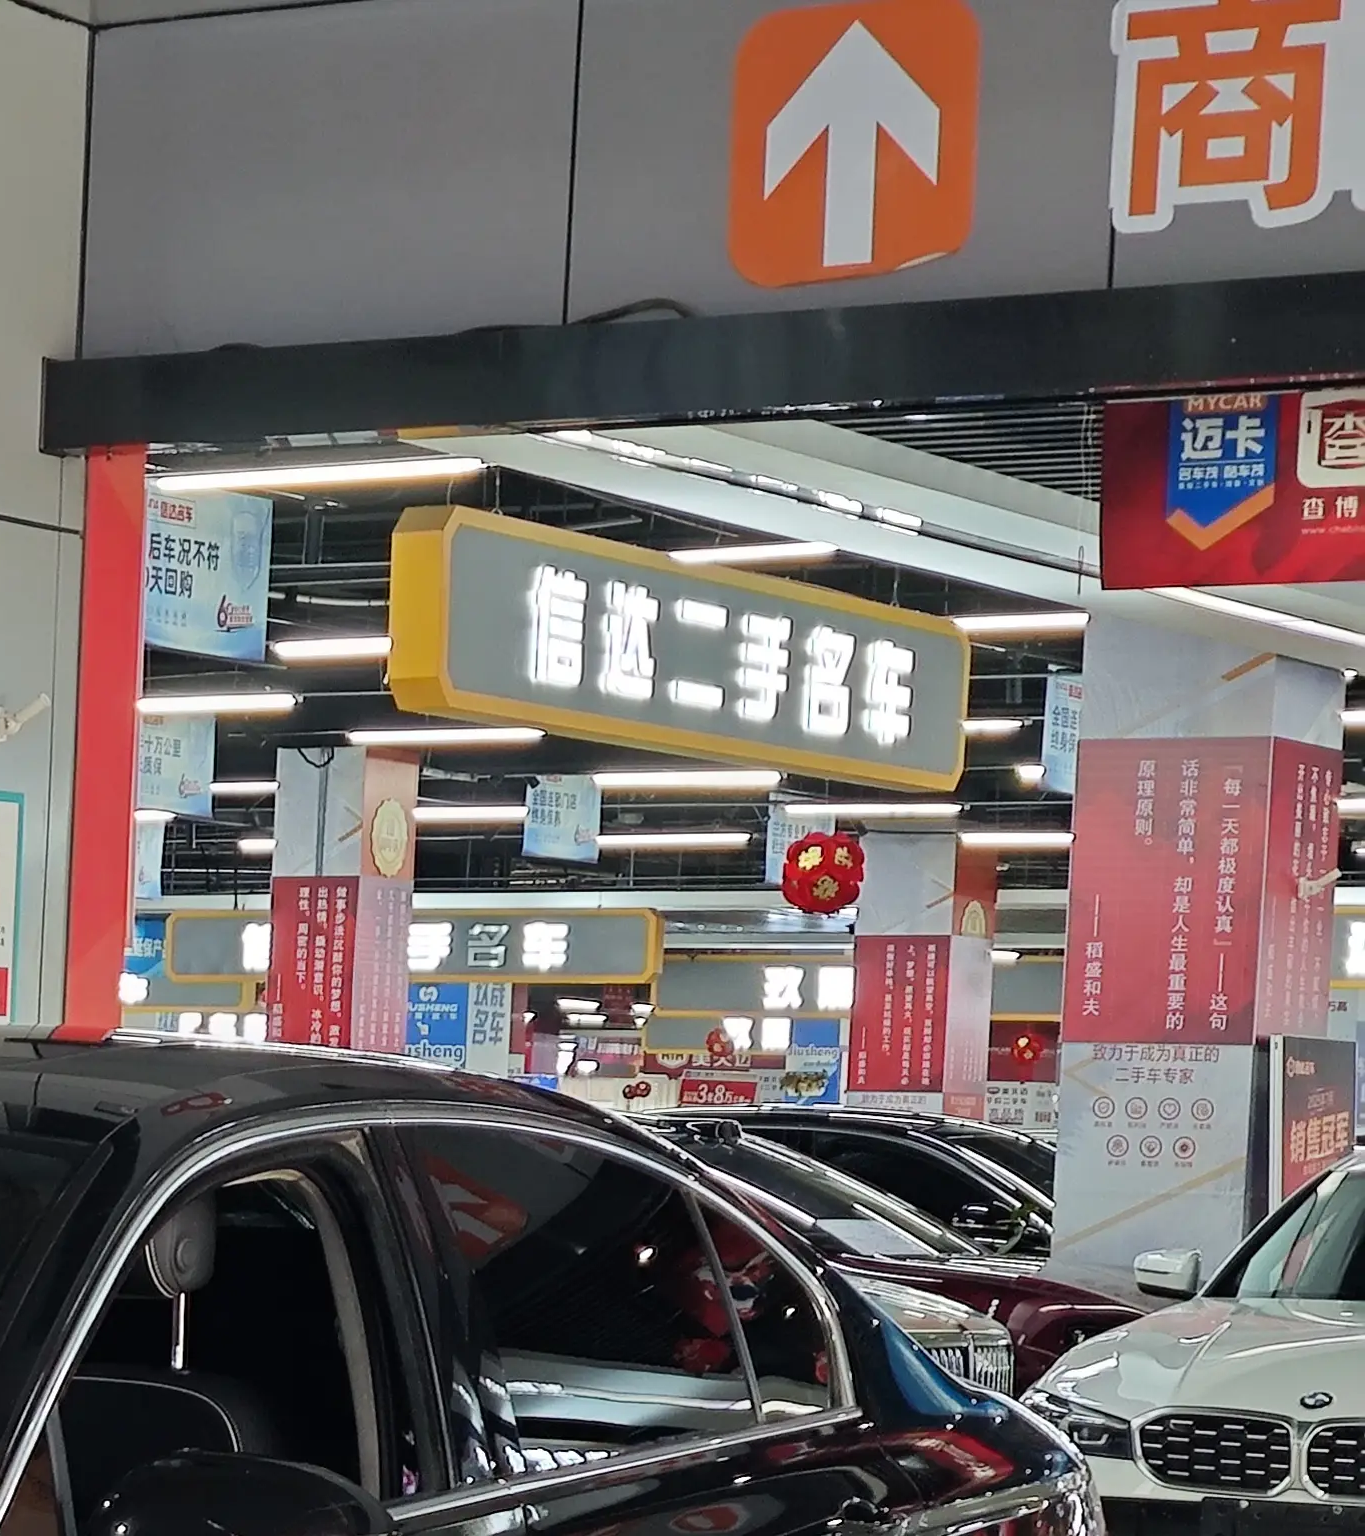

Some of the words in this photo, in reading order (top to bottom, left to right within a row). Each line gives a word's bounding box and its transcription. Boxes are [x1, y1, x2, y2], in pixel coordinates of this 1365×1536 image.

[1127, 0, 1341, 216] 商
[1180, 415, 1265, 460] 迈卡
[531, 562, 917, 746] 信达二手名车
[1165, 759, 1200, 1031] 话非常简单，却是人生最重要的
[1092, 1044, 1220, 1063] 致力于成为真正的
[1115, 1067, 1195, 1084] 二手车专家
[1290, 1111, 1350, 1163] 销售冠军
